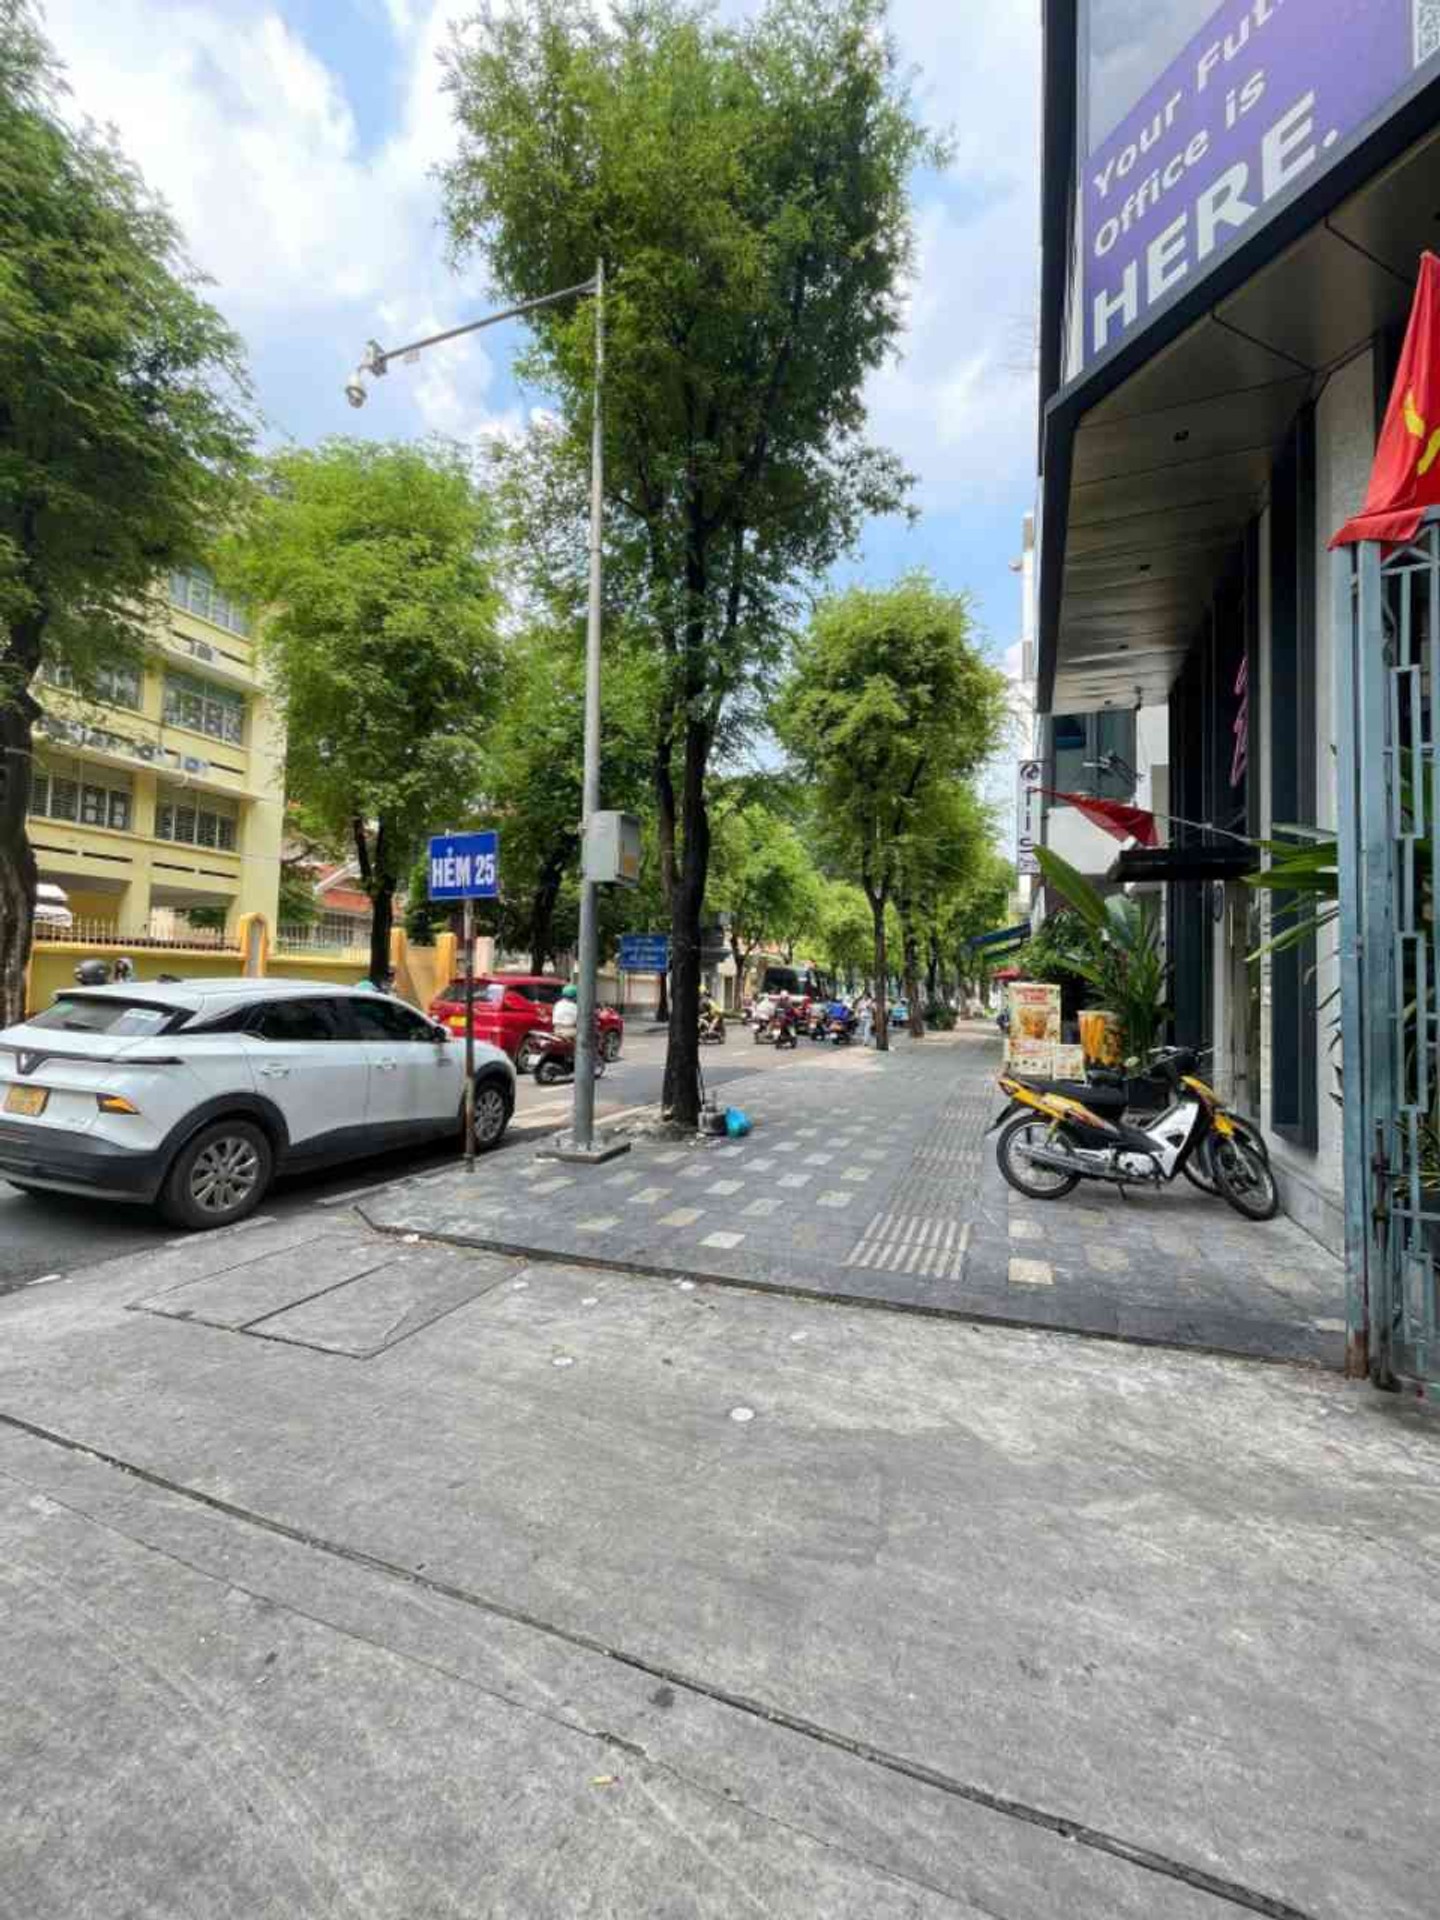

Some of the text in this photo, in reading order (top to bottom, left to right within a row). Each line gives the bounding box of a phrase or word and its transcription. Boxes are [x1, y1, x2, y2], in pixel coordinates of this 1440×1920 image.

[1093, 90, 1182, 197] Your
[1094, 69, 1265, 257] Office is
[1094, 90, 1339, 353] HERE.
[475, 853, 496, 886] 25
